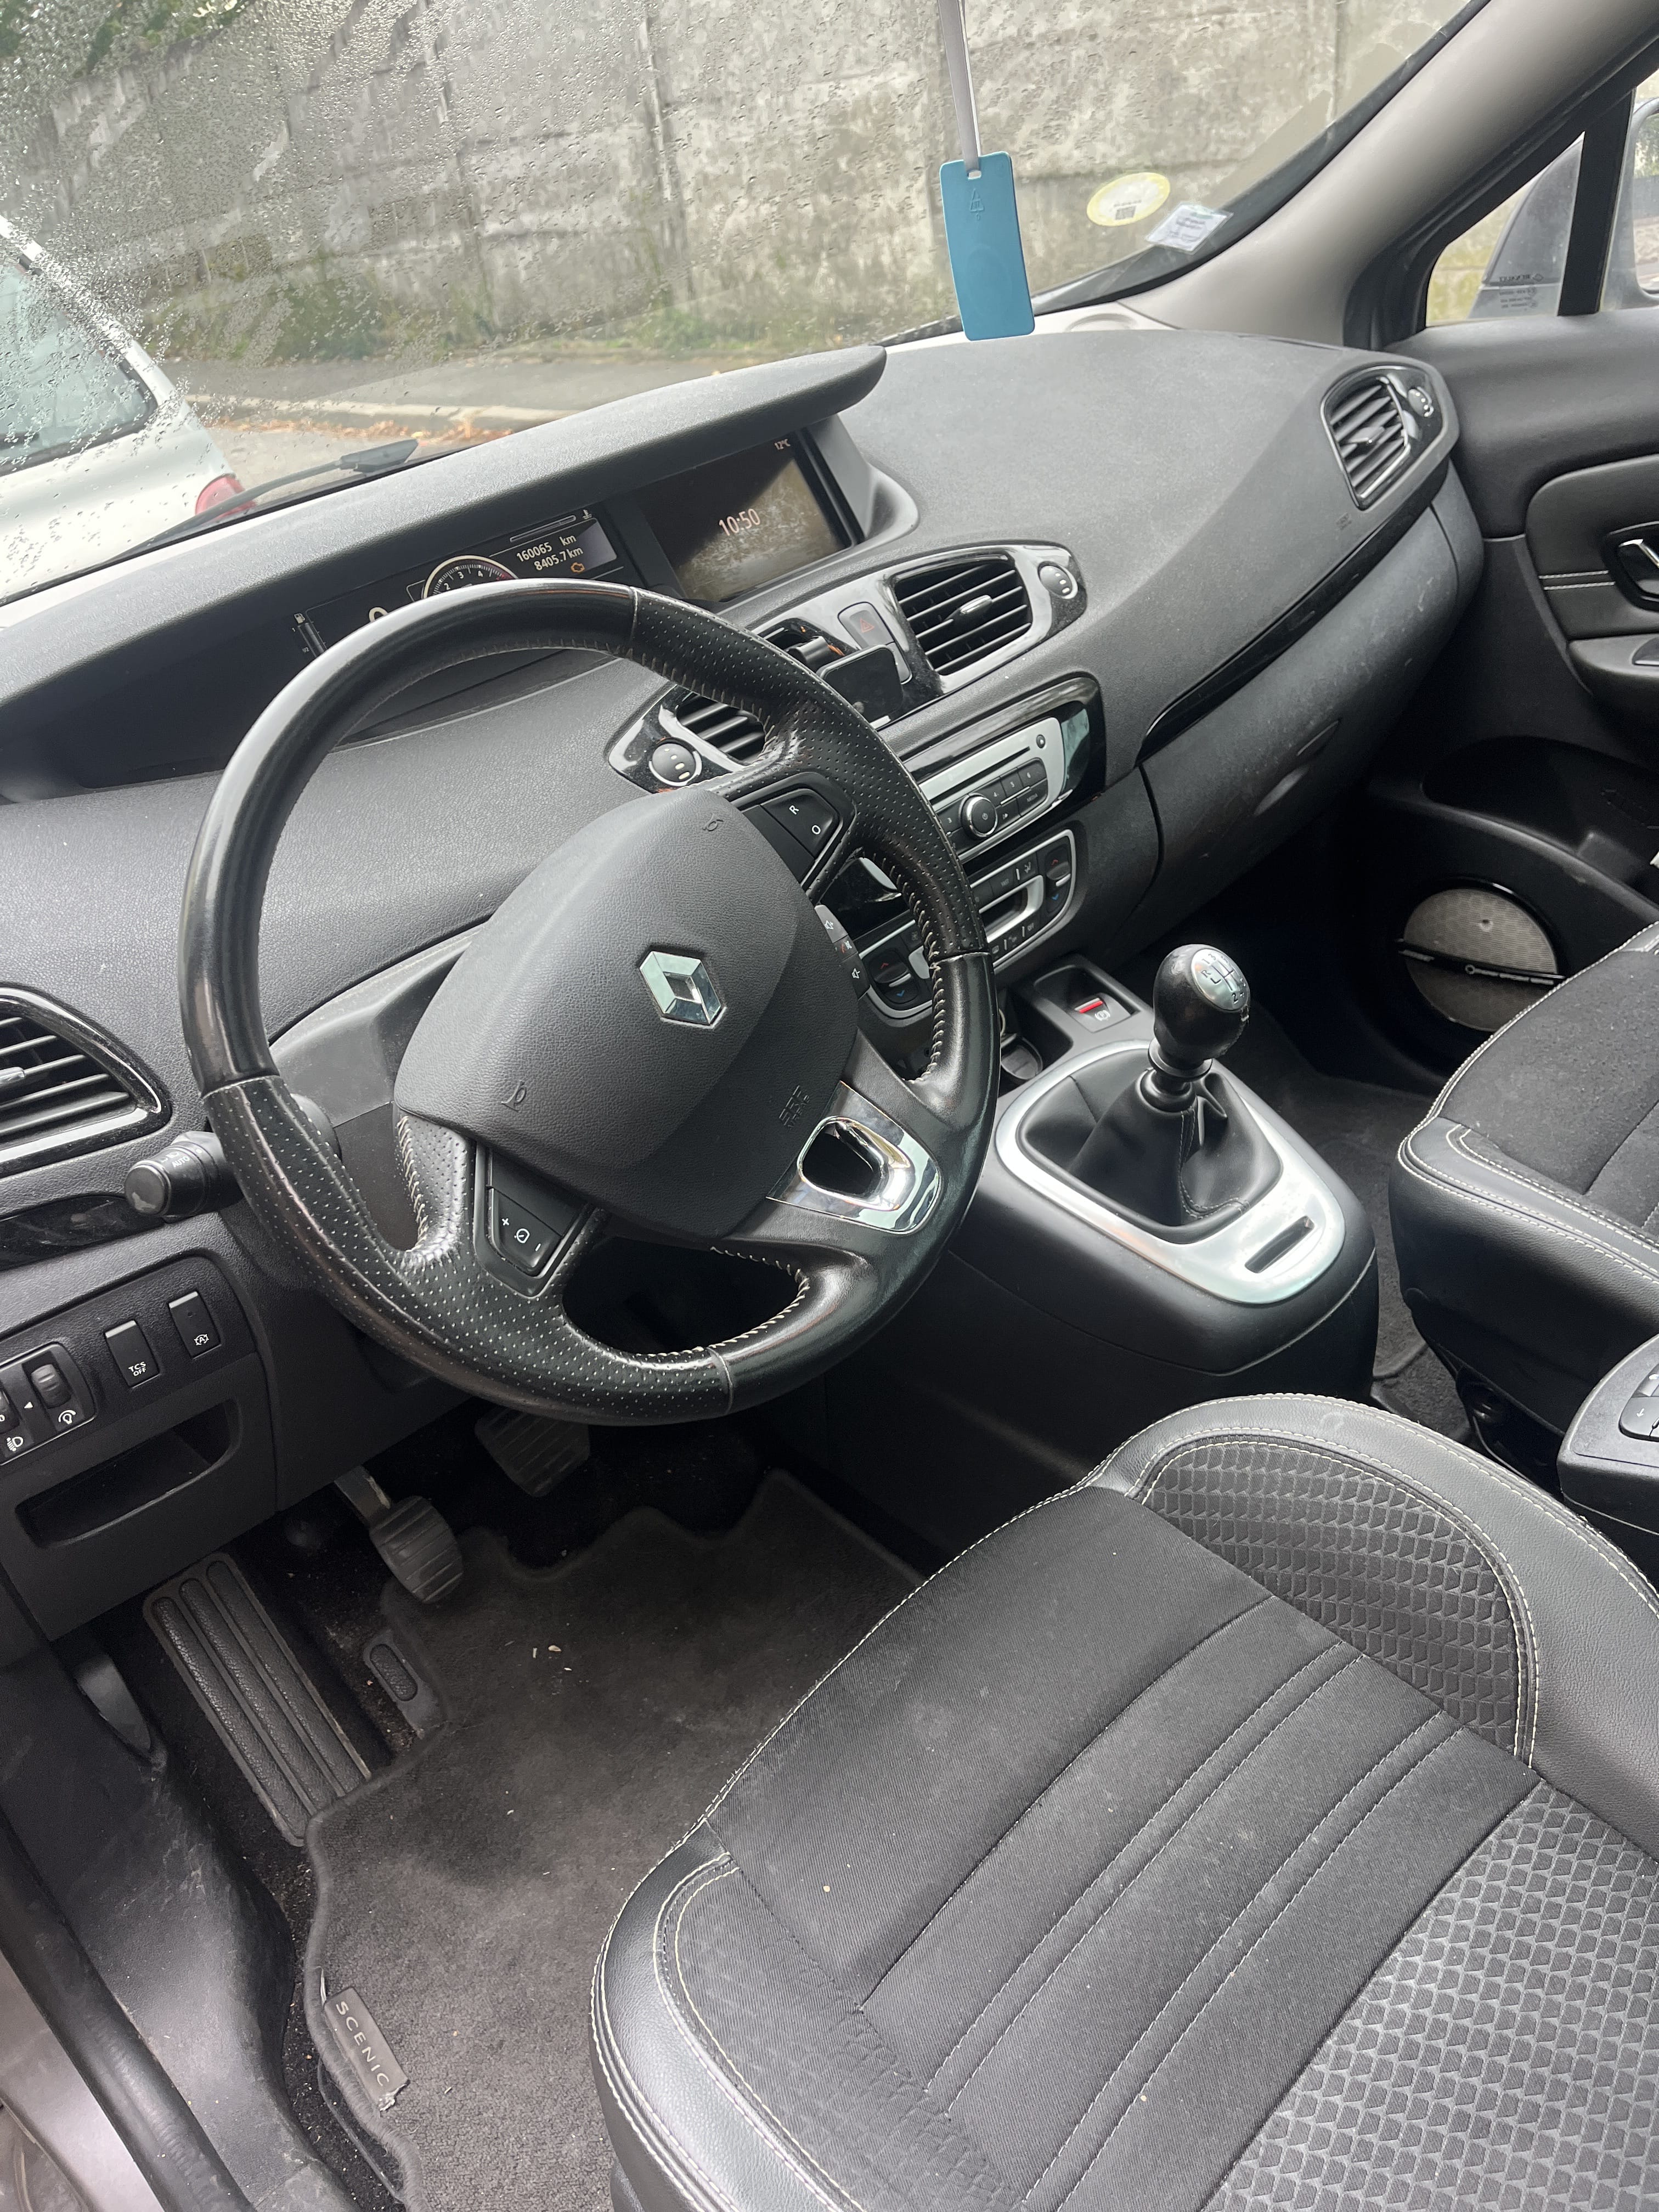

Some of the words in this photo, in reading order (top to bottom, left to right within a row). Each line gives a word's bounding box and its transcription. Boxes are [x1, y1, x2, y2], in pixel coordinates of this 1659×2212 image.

[719, 508, 760, 536] 10:50
[516, 541, 552, 562] 160065
[559, 535, 577, 546] km
[458, 571, 464, 579] 3
[789, 805, 799, 815] R
[1201, 969, 1211, 978] R
[1232, 992, 1239, 1004] 2
[172, 1155, 190, 1168] AUTO
[128, 1361, 146, 1372] TCS
[133, 1367, 146, 1376] OFF
[335, 2001, 390, 2087] SCENIC
